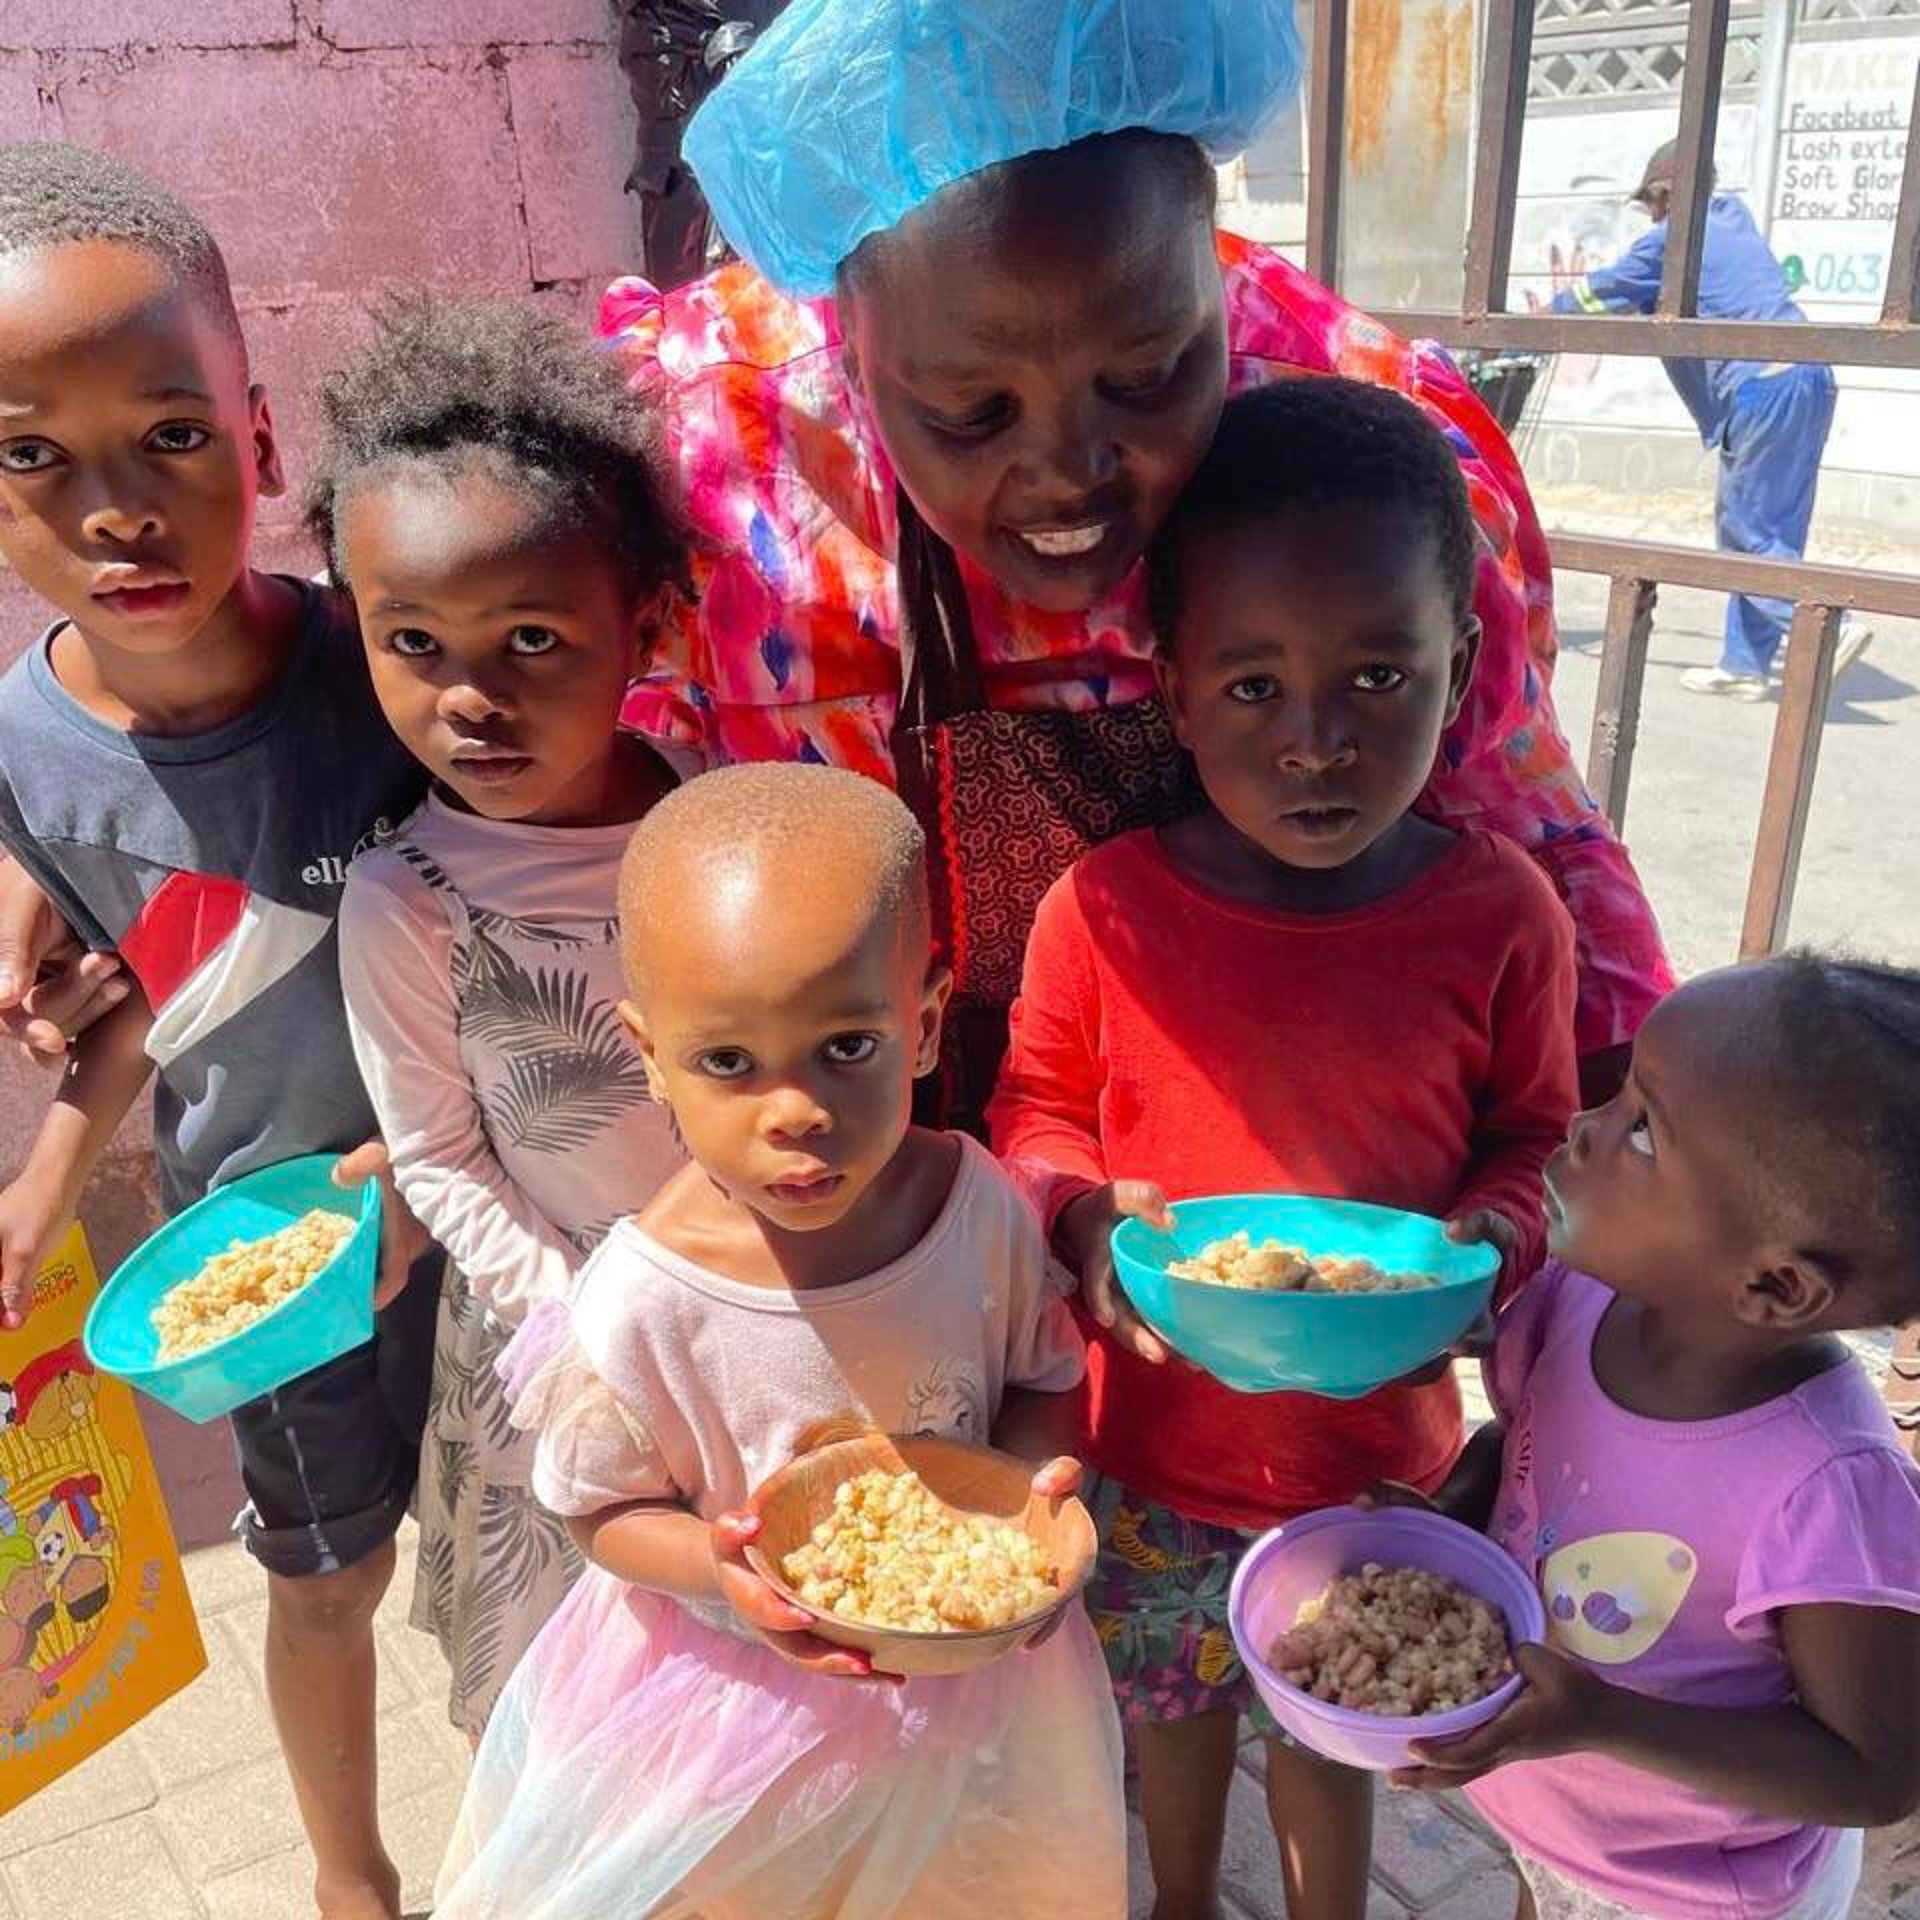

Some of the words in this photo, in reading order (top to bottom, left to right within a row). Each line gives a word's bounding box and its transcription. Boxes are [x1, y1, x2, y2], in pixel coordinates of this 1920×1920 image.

[1791, 100, 1900, 131] Facebeat
[1784, 165, 1839, 190] Soft
[1781, 192, 1838, 219] Brow
[1815, 253, 1883, 293] 063
[301, 857, 352, 885] ell
